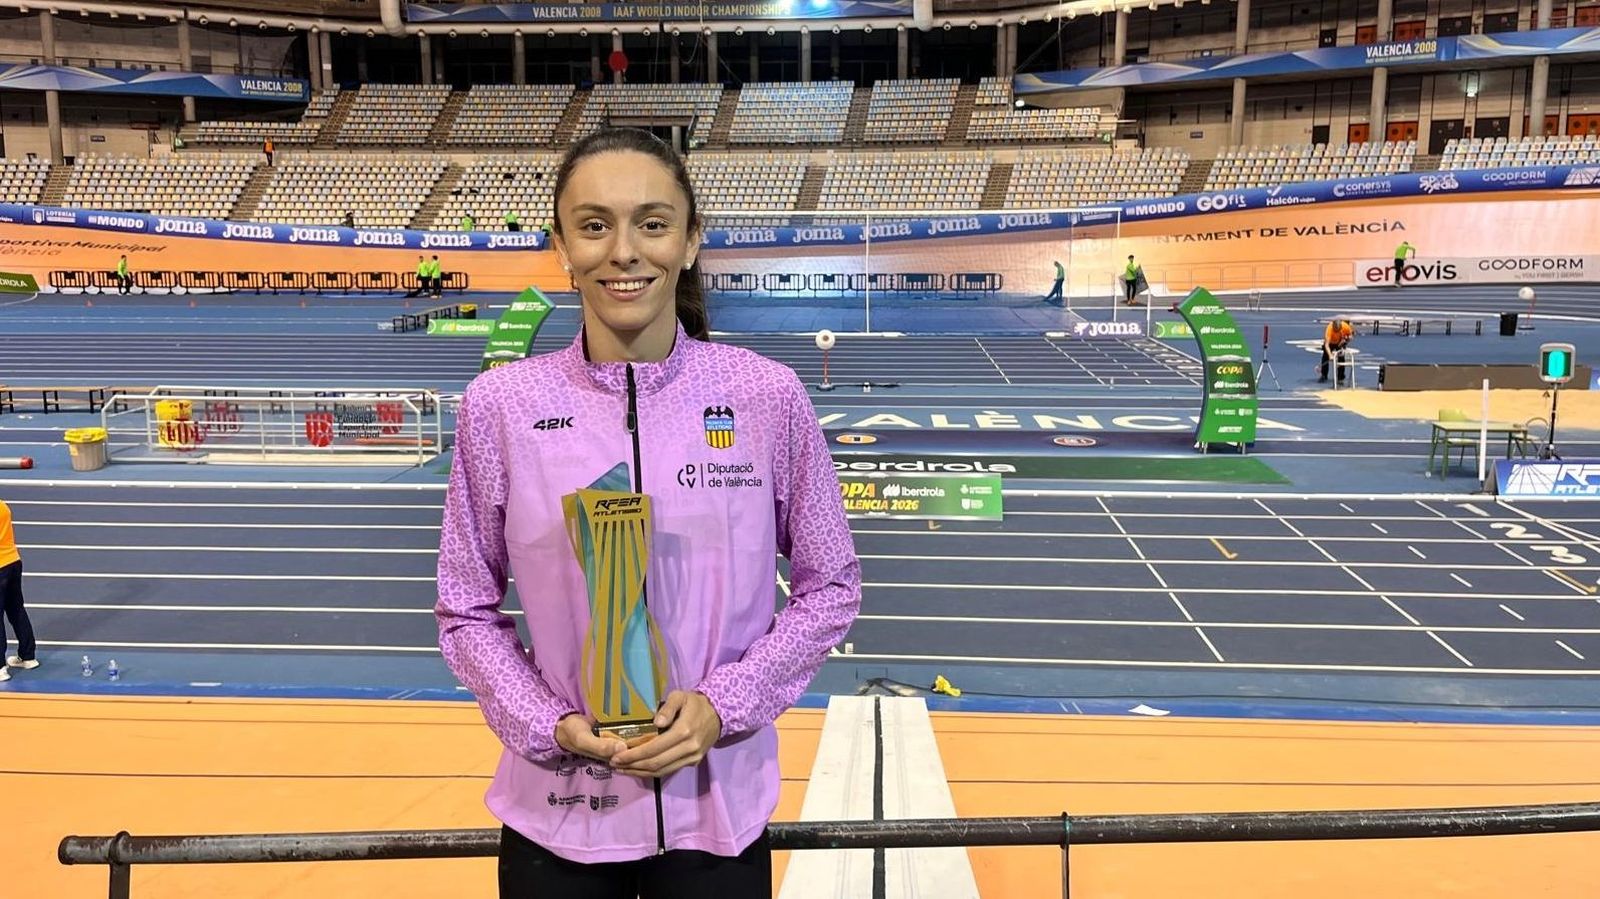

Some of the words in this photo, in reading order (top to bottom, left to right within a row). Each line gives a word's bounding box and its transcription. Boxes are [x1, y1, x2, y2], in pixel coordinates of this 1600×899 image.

[533, 7, 578, 18] VALENCIA
[580, 7, 601, 17] 2008
[613, 6, 635, 17] IAAF
[637, 6, 671, 17] WORLD
[673, 5, 709, 17] INDOOR
[1366, 43, 1412, 58] VALENCIA
[1414, 41, 1437, 54] 2008
[240, 80, 281, 91] VALENCIA
[284, 82, 303, 92] 2008
[1482, 171, 1546, 182] GOODFORM
[1266, 196, 1299, 206] Halcón
[1135, 201, 1186, 215] MONDO
[97, 216, 144, 228] MONDO
[1260, 227, 1289, 238] DE
[1366, 260, 1457, 282] enovis
[1479, 258, 1583, 271] GOODFORM
[1216, 365, 1243, 375] COPA
[533, 416, 575, 431] 42K
[707, 462, 754, 475] Diputació
[708, 478, 723, 487] de
[724, 477, 763, 487] València
[902, 487, 945, 497] Iberdrola
[595, 497, 642, 510] RFEA
[891, 500, 920, 511] 2026
[1456, 503, 1491, 517] 1
[1489, 522, 1544, 539] 2
[1529, 545, 1587, 564] 3
